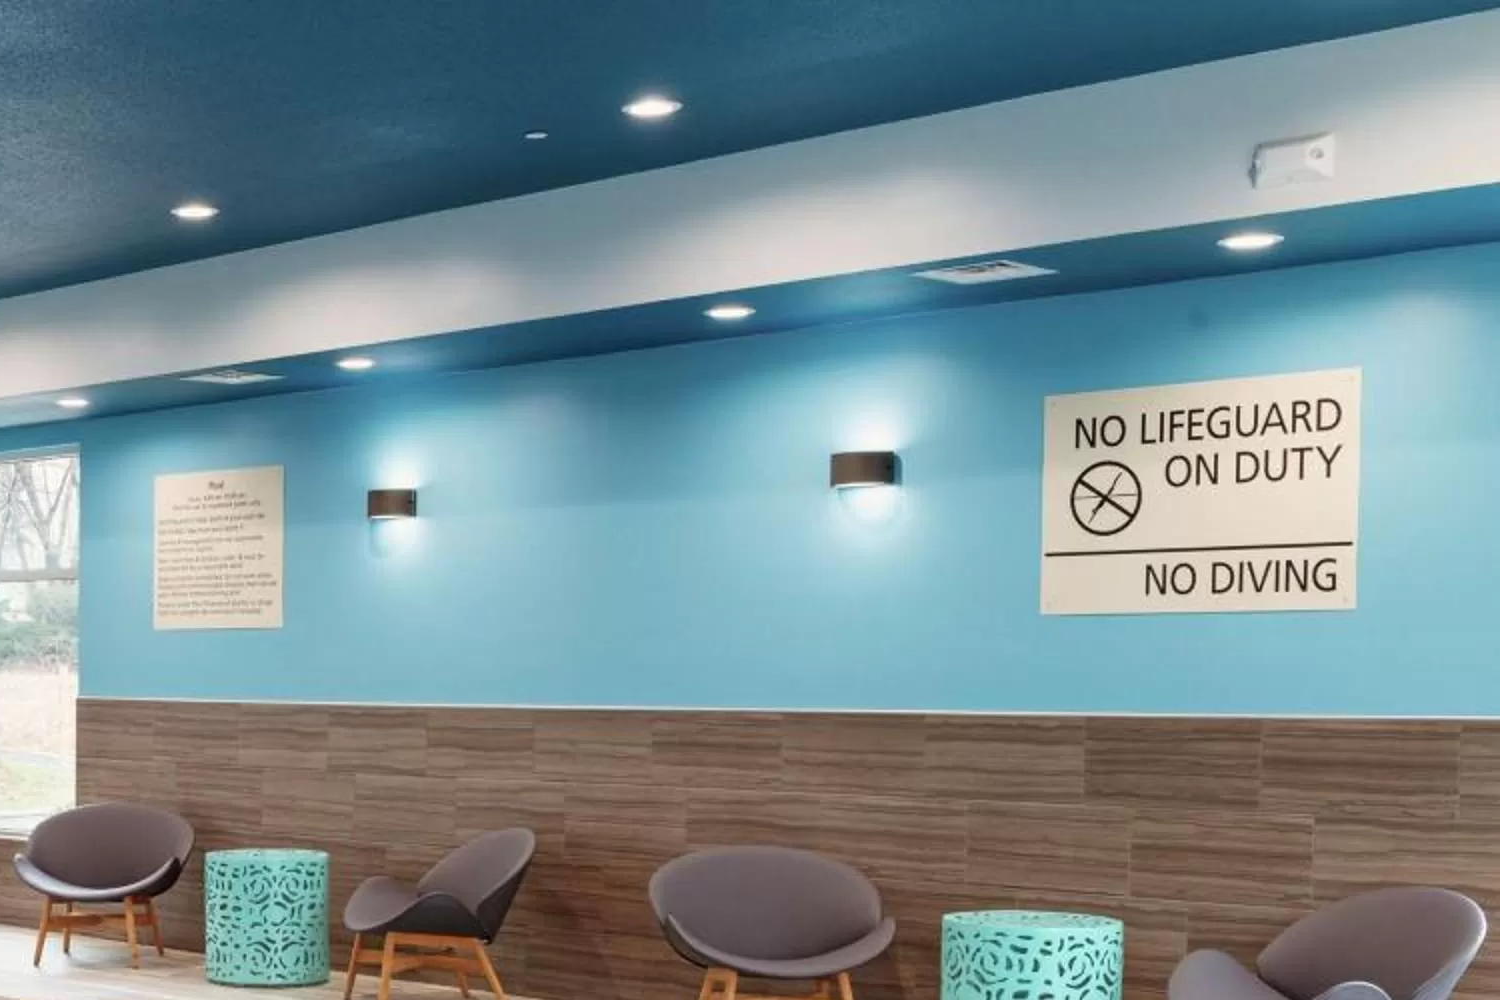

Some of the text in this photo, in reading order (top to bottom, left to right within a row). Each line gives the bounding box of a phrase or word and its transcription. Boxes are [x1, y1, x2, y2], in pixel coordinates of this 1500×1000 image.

[1074, 397, 1342, 449] NO LIFEGUARD
[1165, 443, 1343, 487] ON DUTY
[1145, 557, 1338, 596] NO DIVING
